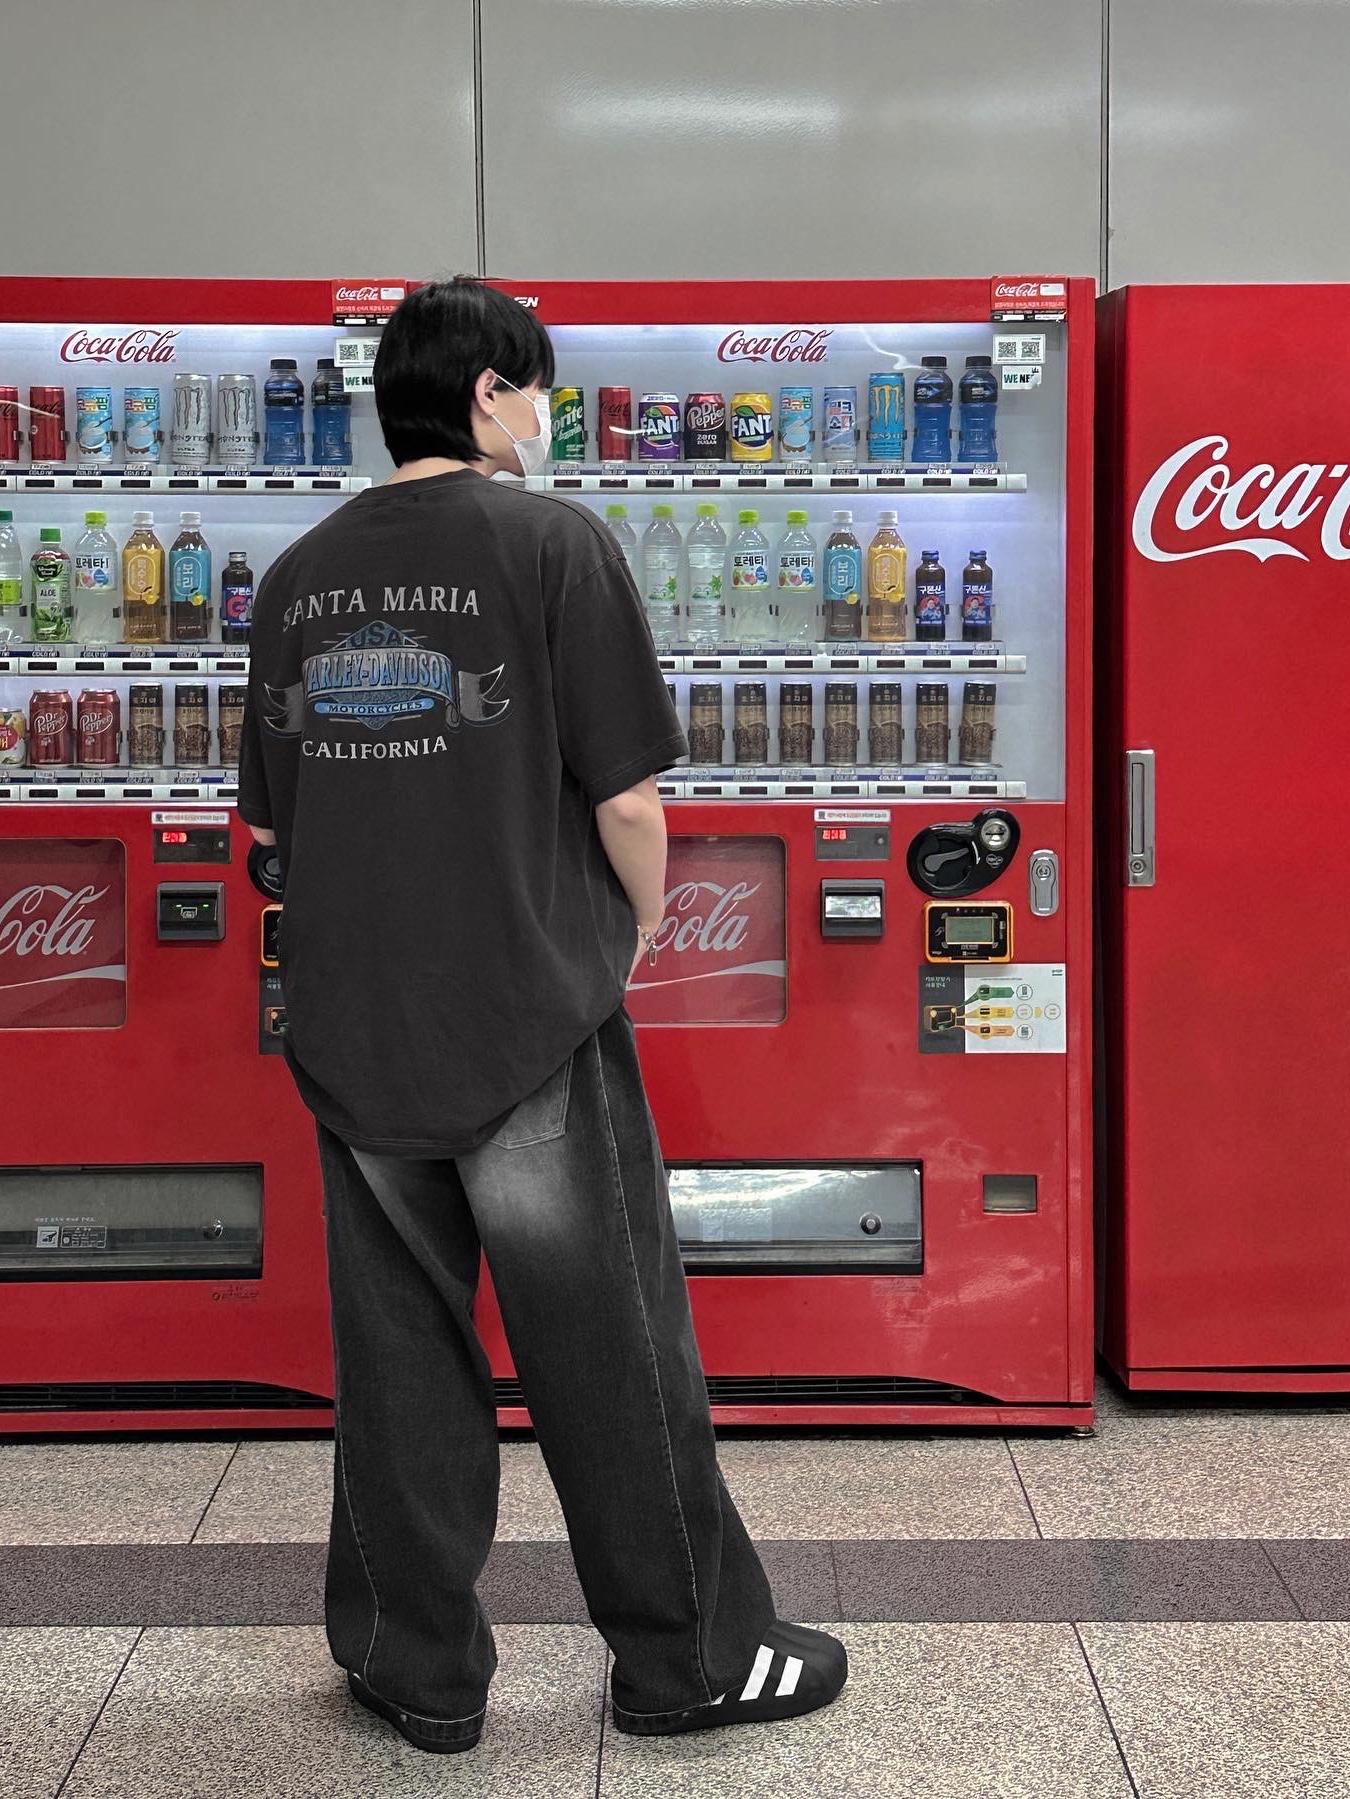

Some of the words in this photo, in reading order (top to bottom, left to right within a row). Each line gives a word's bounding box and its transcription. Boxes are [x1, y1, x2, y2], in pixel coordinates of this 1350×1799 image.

[60, 329, 182, 364] Coca-Cola
[717, 329, 834, 364] Coca-Cola
[1003, 374, 1018, 384] WE
[687, 406, 725, 429] Pepper
[701, 402, 718, 416] Dr
[640, 415, 680, 436] FANT
[731, 414, 772, 437] FANT
[283, 588, 367, 632] SANTA
[382, 586, 481, 616] MARIA
[350, 622, 405, 647] USA
[45, 712, 58, 721] Dr
[90, 712, 102, 721] Dr
[327, 701, 423, 714] MOTORCYCLES
[302, 735, 448, 760] CALIFORNIA
